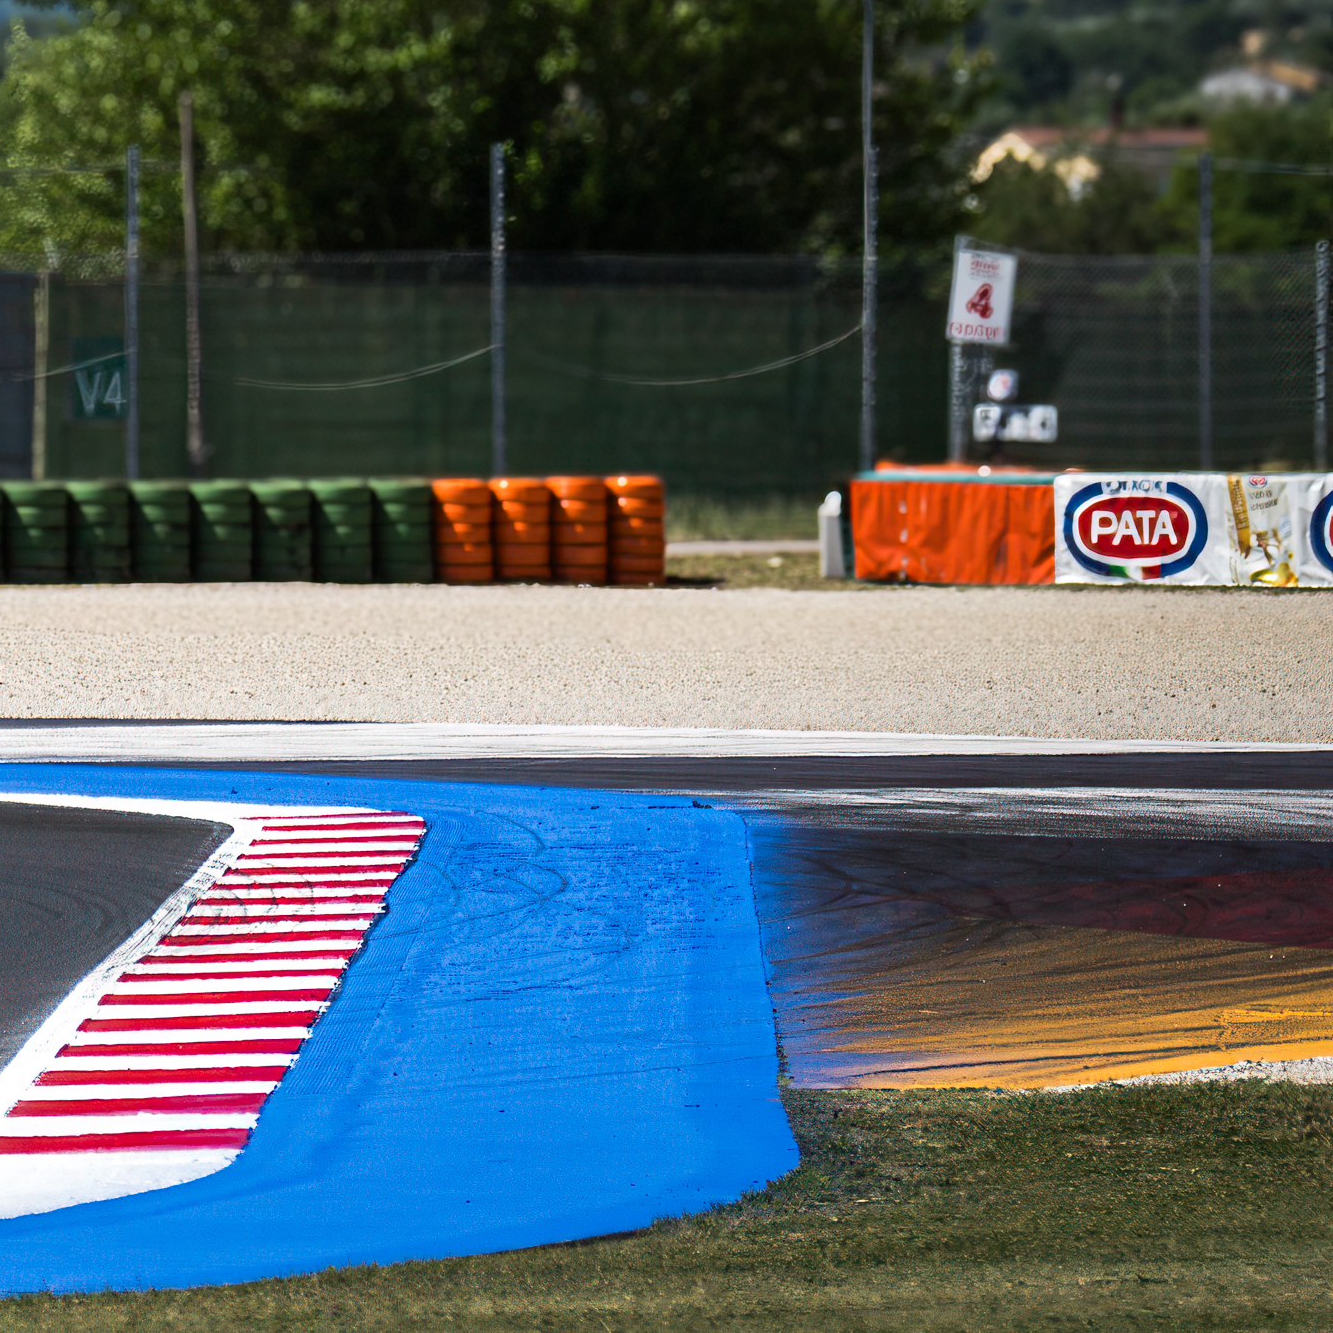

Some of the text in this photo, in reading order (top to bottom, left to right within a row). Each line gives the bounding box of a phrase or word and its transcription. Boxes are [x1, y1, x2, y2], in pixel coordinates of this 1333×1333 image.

[965, 282, 994, 319] 4
[74, 370, 127, 416] V4
[1090, 509, 1178, 546] PATA
